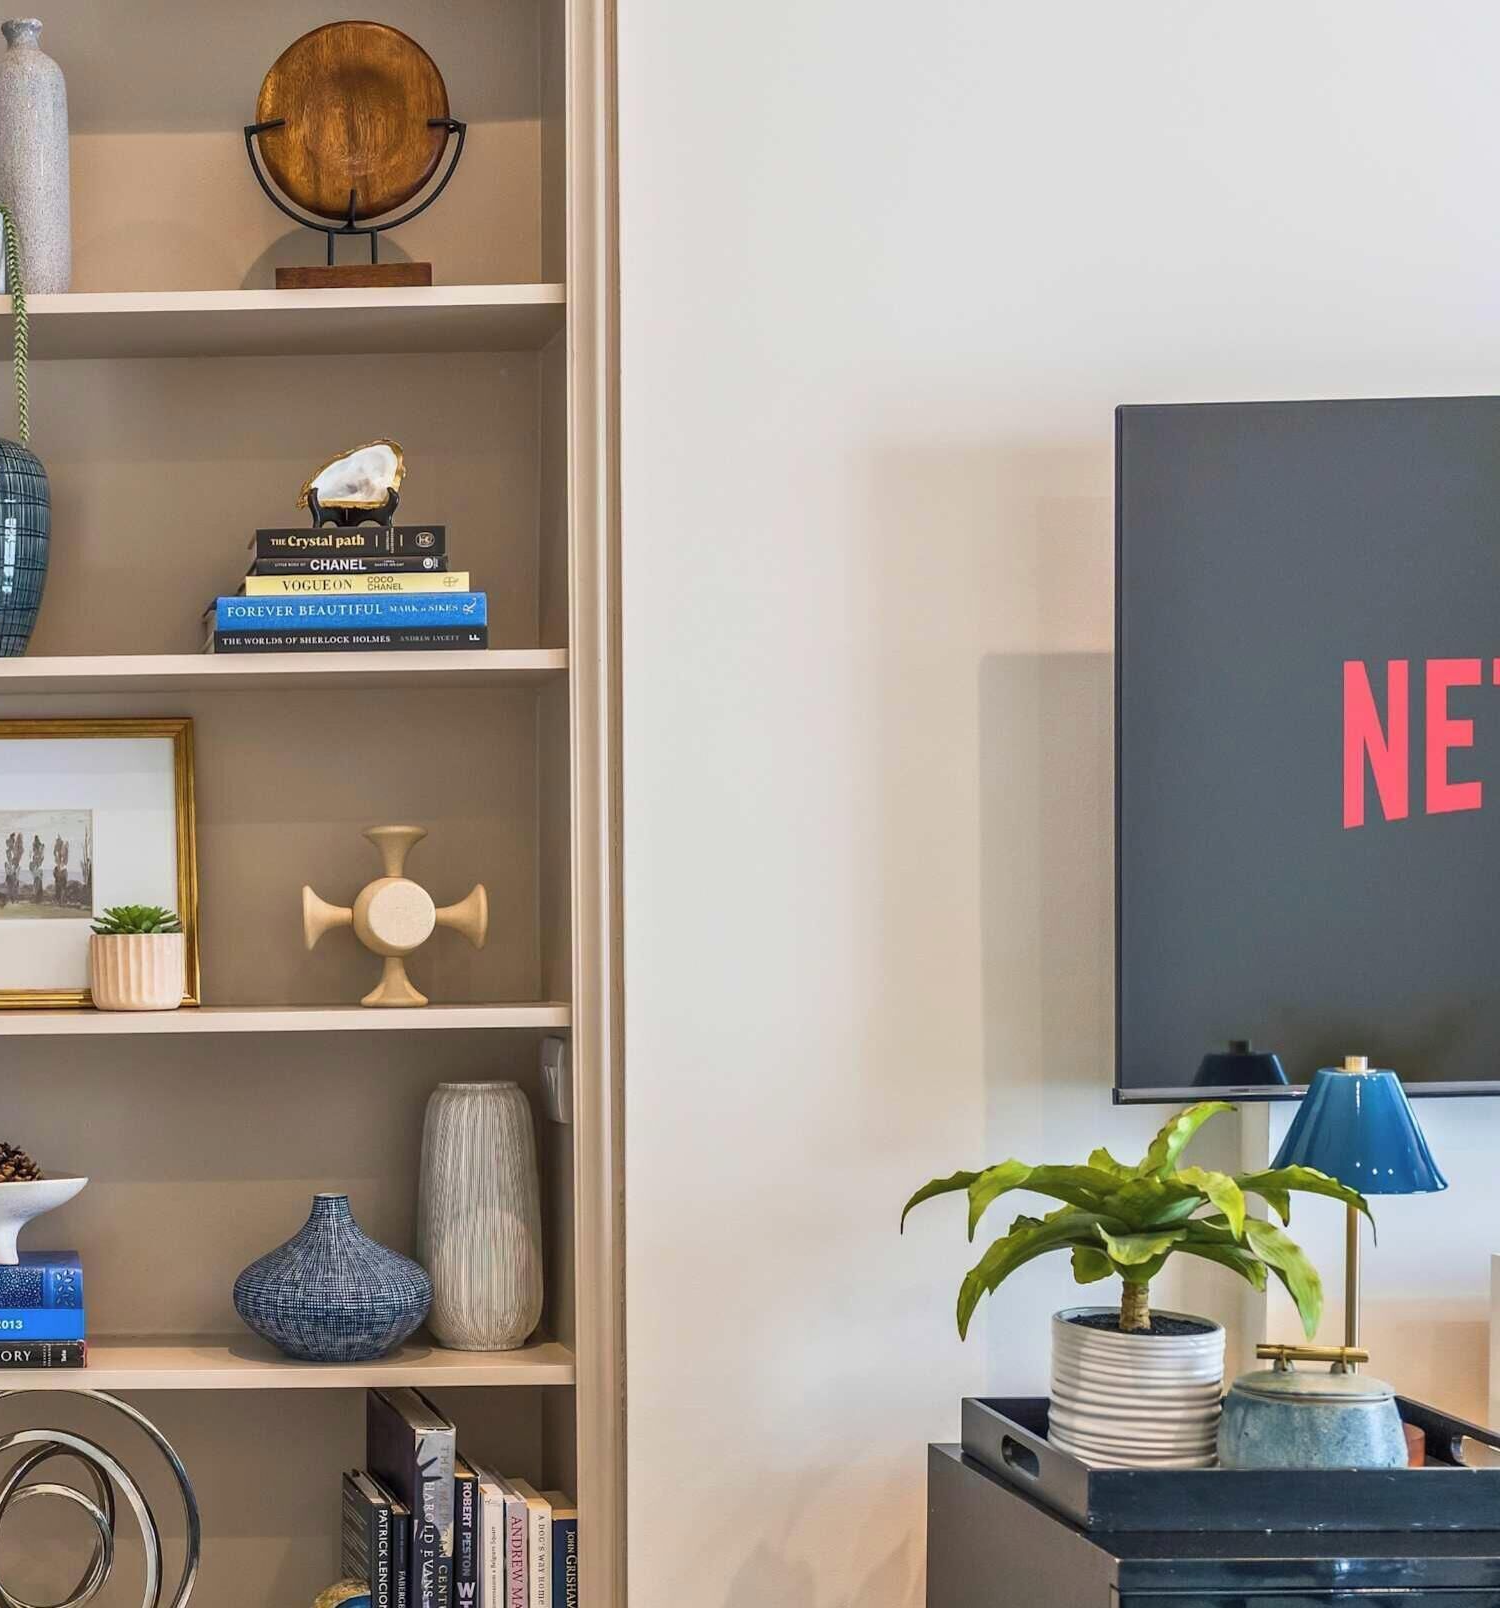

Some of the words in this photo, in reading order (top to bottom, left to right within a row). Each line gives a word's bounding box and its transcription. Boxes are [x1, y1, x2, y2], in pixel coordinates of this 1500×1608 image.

[271, 537, 287, 546] THE
[287, 536, 333, 550] Crystal
[335, 534, 365, 549] path
[283, 580, 330, 592] VOGUE
[333, 580, 352, 591] ON
[310, 559, 367, 571] CHANEL
[367, 583, 403, 591] CHANEL
[227, 606, 294, 618] FOREVER
[299, 604, 382, 616] BEAUTIFUL
[389, 604, 418, 612] MARK
[428, 603, 458, 612] SIKES
[222, 637, 242, 646] THE
[244, 637, 283, 646] WORLDS
[286, 636, 298, 645] OF
[299, 635, 349, 644] SHERLOCK
[352, 635, 391, 644] HOLMES
[1343, 658, 1500, 830] NE
[439, 1445, 449, 1475] THE
[423, 1481, 434, 1543] HAROLD
[438, 1481, 449, 1558] AMERICAN
[462, 1482, 472, 1528] ROBERT
[378, 1509, 388, 1557] PATRICK
[462, 1532, 472, 1576] PESTON
[511, 1516, 522, 1583] ANDREW
[565, 1530, 576, 1554] JOHN
[423, 1550, 434, 1598] EVANS
[438, 1565, 448, 1608] CENT
